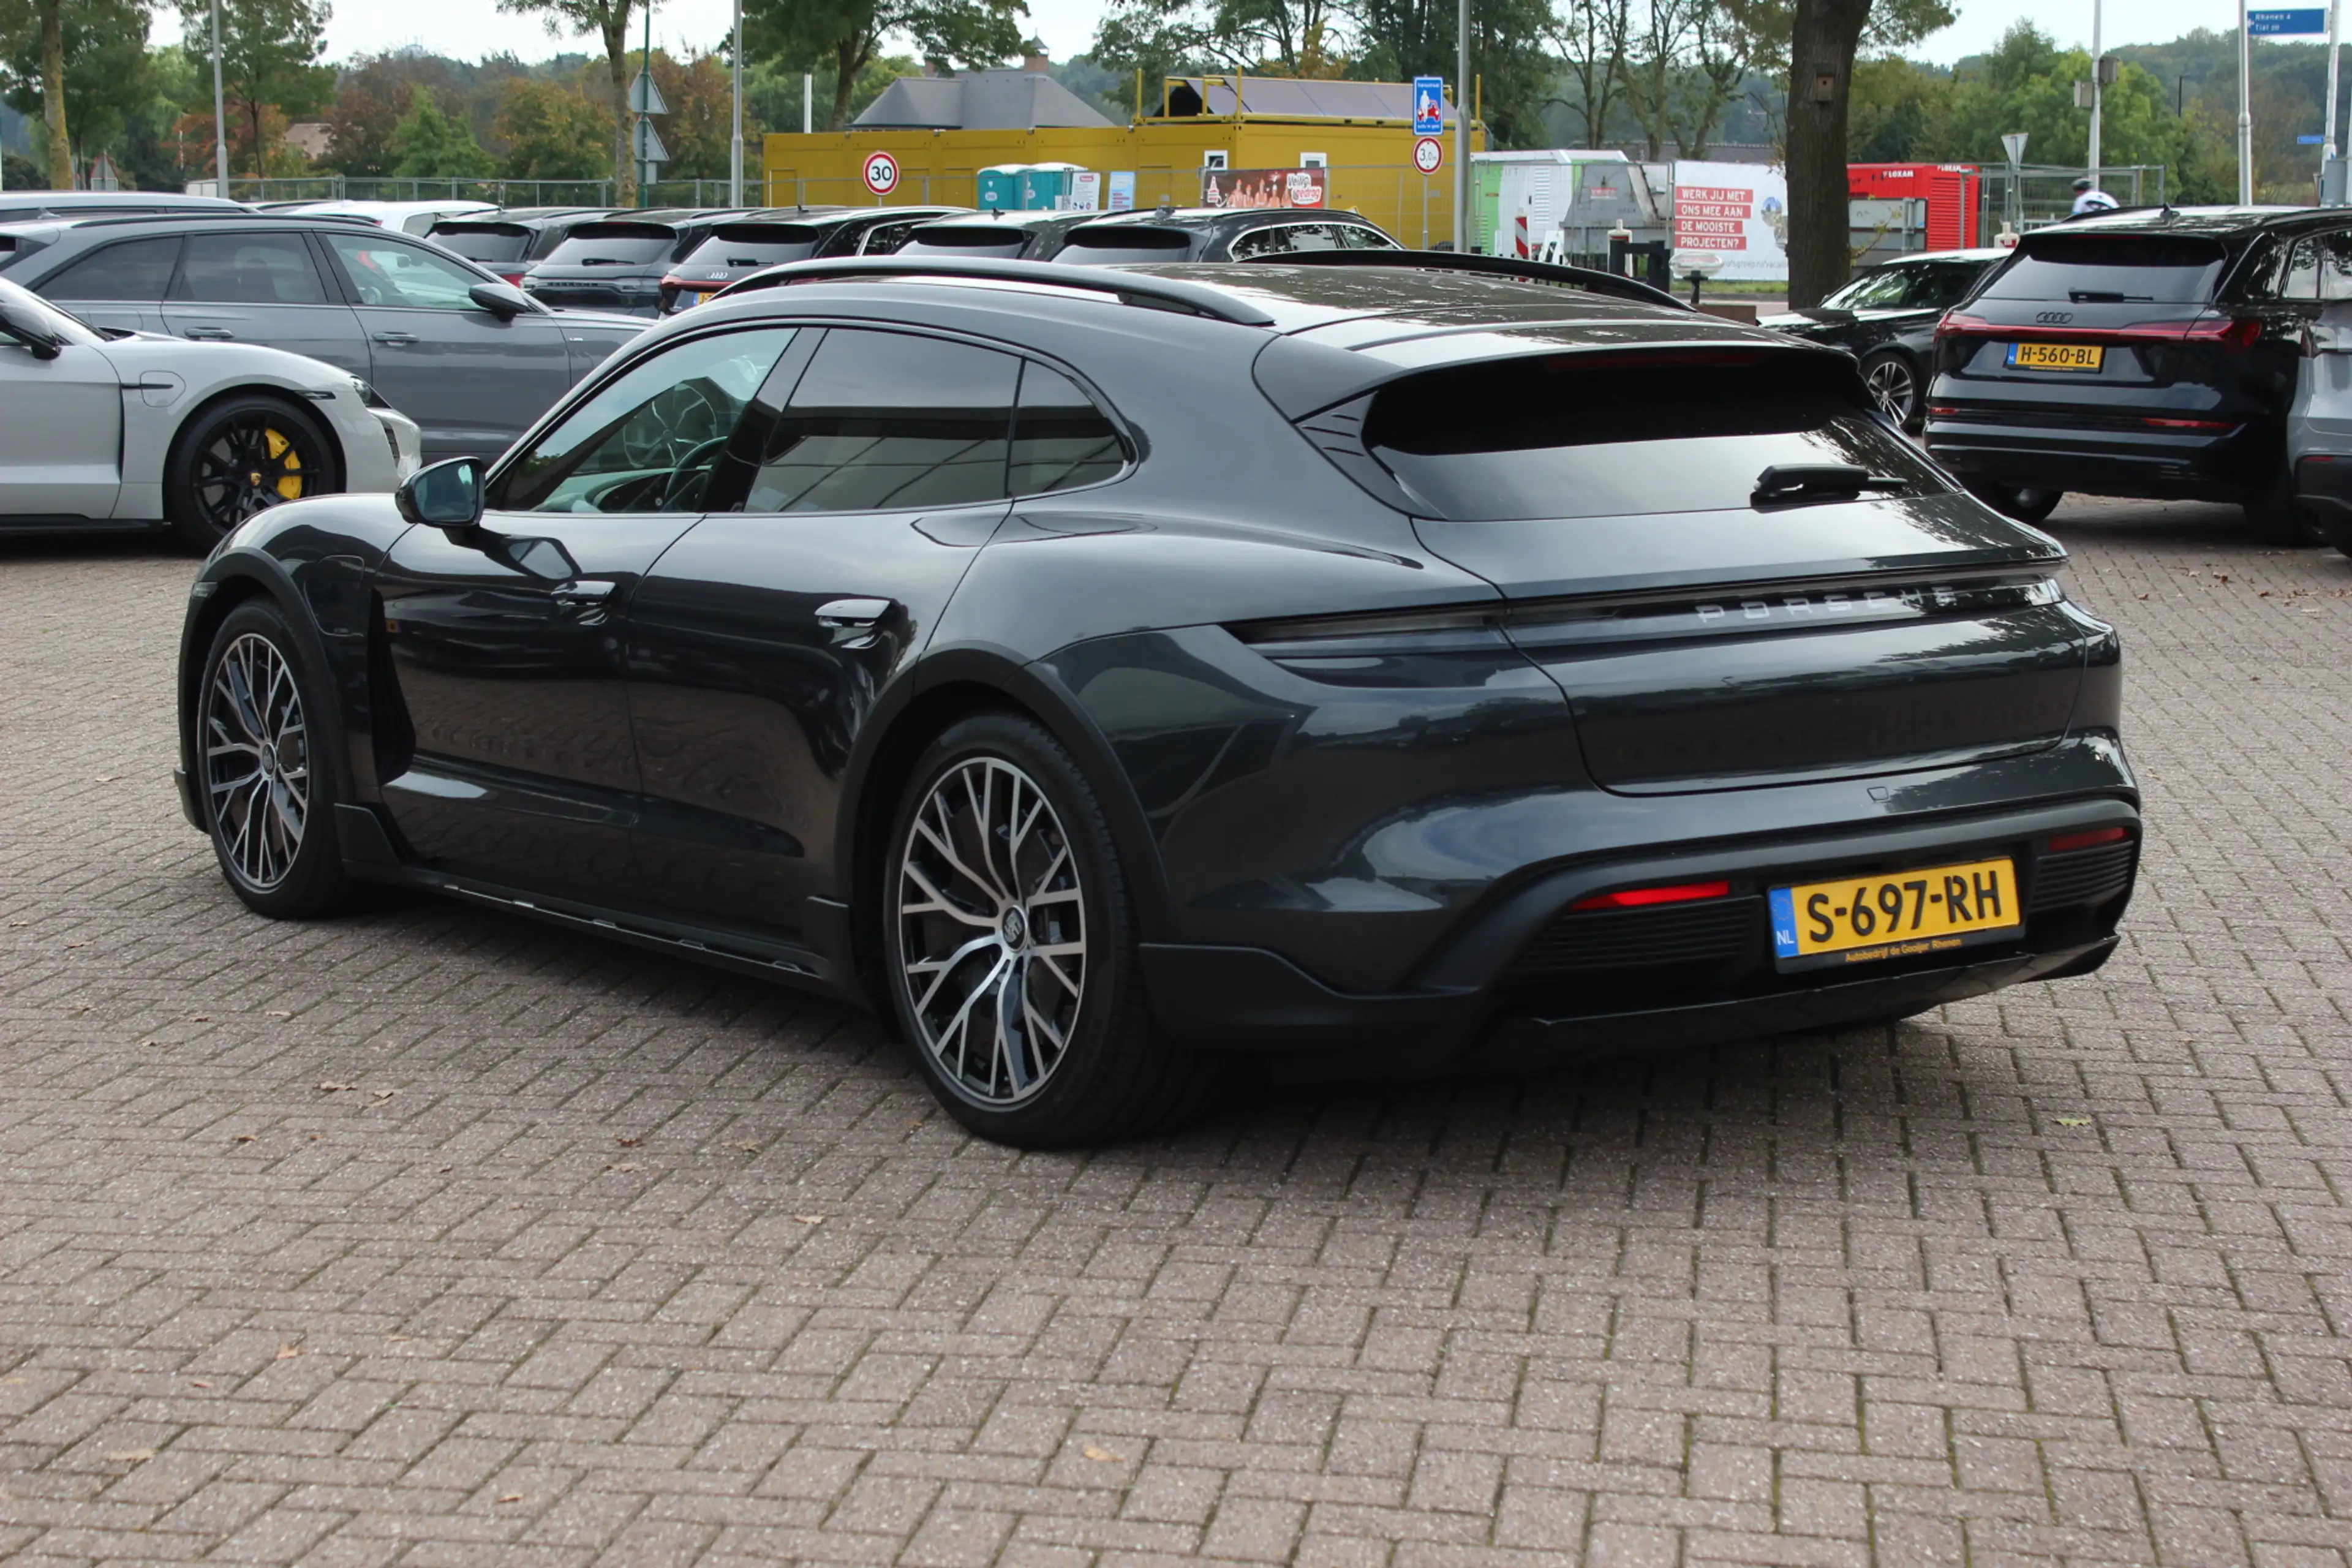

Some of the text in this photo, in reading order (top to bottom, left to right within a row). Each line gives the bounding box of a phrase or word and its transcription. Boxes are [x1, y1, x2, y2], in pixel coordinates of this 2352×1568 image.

[872, 165, 892, 181] 30
[1682, 188, 1746, 201] WERK JIJ MET
[1681, 203, 1743, 217] ONS MEE AAN
[1681, 221, 1735, 232] DE MOOISTE
[1681, 236, 1739, 249] PROJECTEN?
[2021, 345, 2095, 365] H-560-BL
[1695, 586, 1957, 624] PORSCHE
[1776, 870, 2002, 945] NL S-697-RH
[1845, 947, 1888, 962] Autobedrijf
[1890, 947, 1900, 956] de
[1931, 939, 1962, 949] Rhenen
